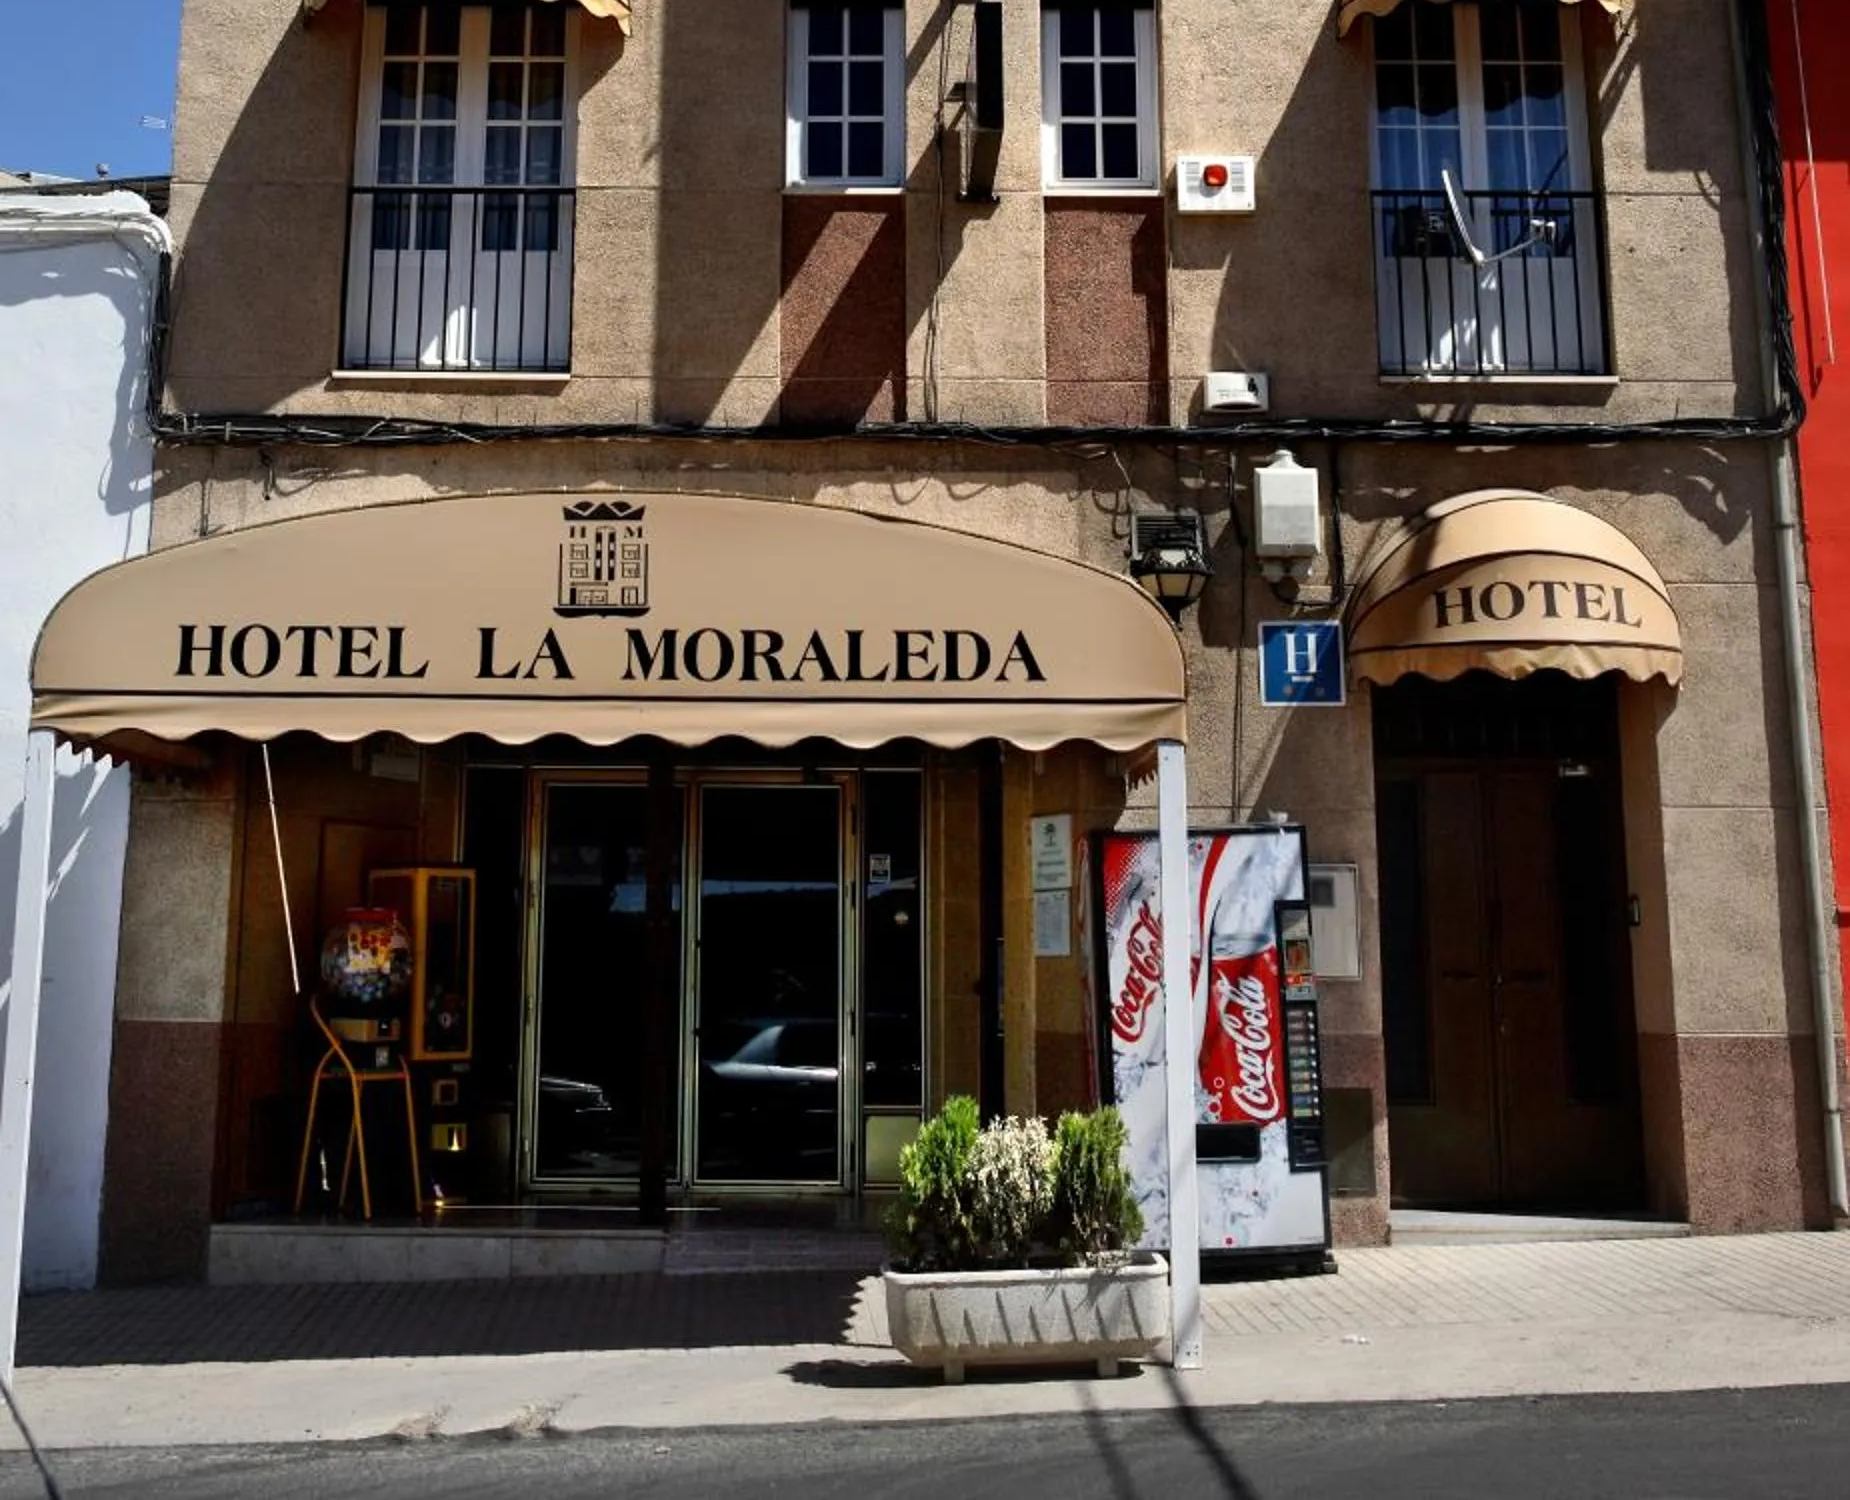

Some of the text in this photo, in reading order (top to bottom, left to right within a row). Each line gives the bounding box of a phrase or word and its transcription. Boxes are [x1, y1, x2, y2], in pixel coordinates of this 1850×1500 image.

[1433, 580, 1643, 629] HOTEL
[173, 623, 1047, 682] HOTEL LA MORALEDA
[1284, 632, 1318, 674] H
[1111, 900, 1164, 1043] Coca-Col
[1213, 968, 1280, 1120] Coca-Cola
